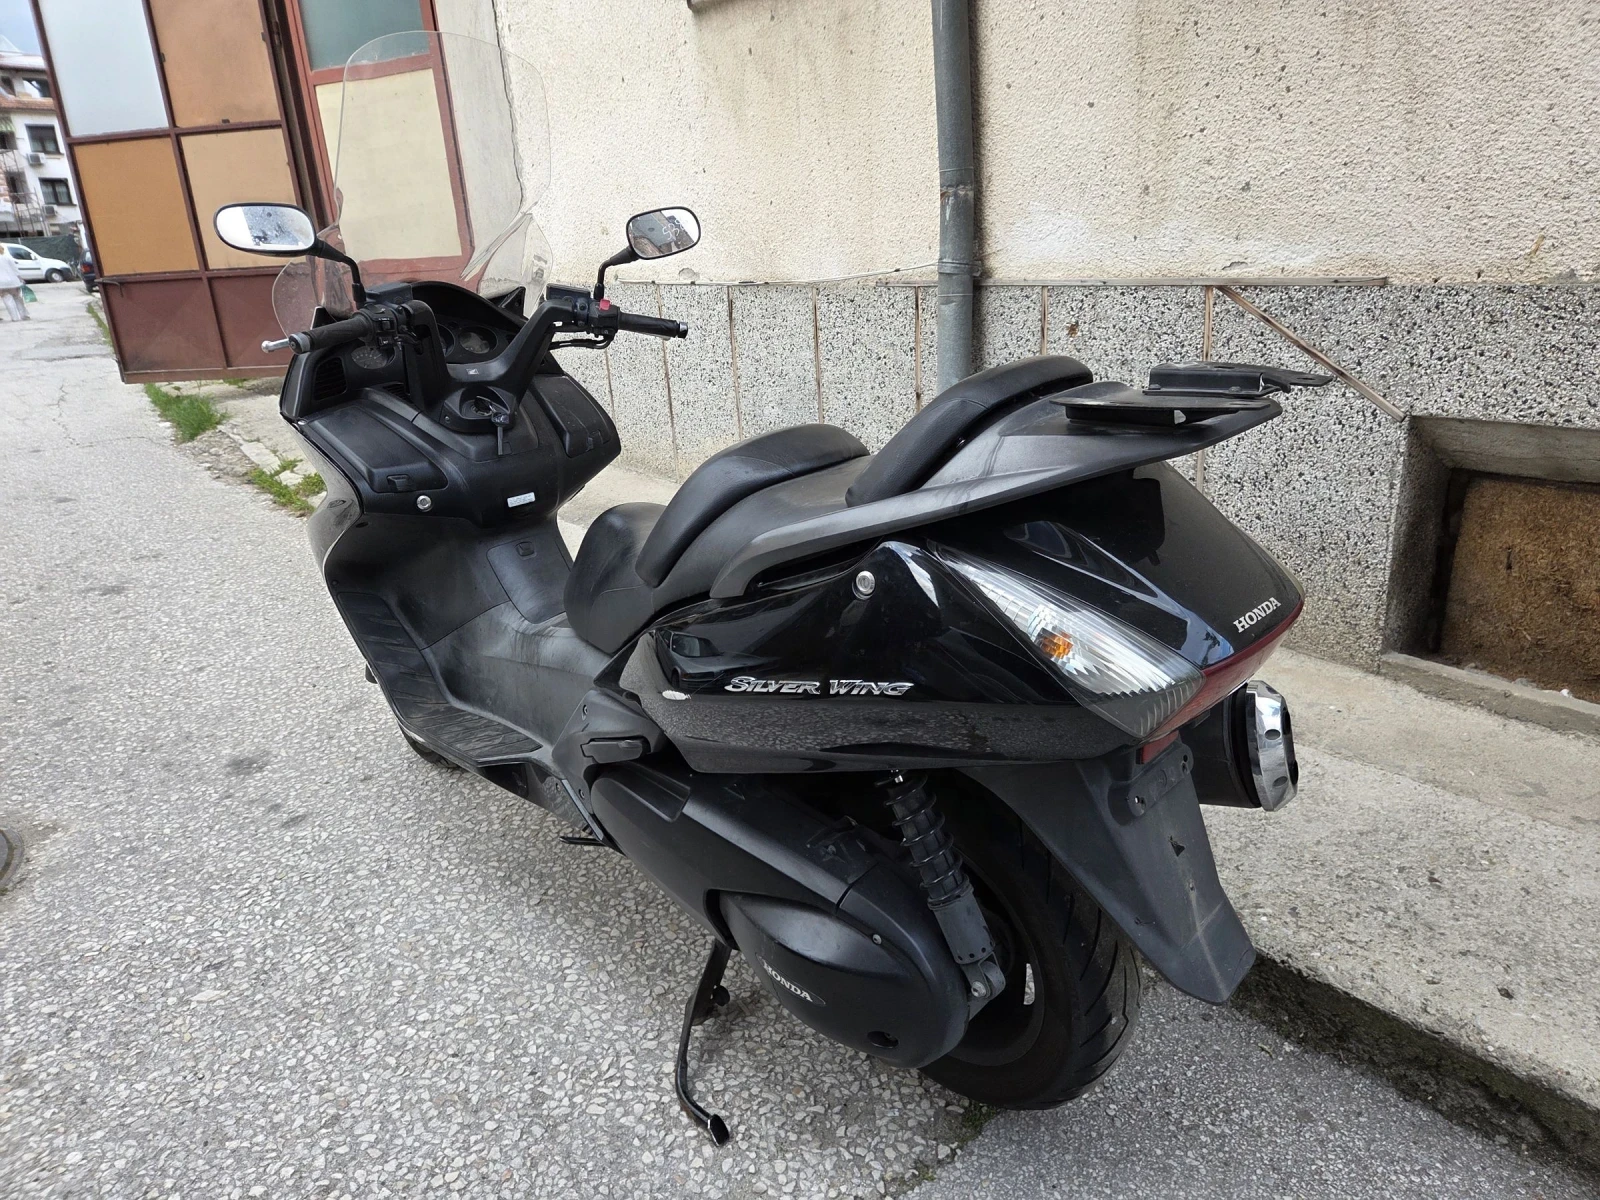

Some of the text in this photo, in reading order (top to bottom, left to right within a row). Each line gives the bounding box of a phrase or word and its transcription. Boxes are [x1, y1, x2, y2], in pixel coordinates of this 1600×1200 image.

[1233, 597, 1281, 633] HONDA
[724, 676, 914, 696] SILVER WING
[762, 959, 813, 1002] HONDA
